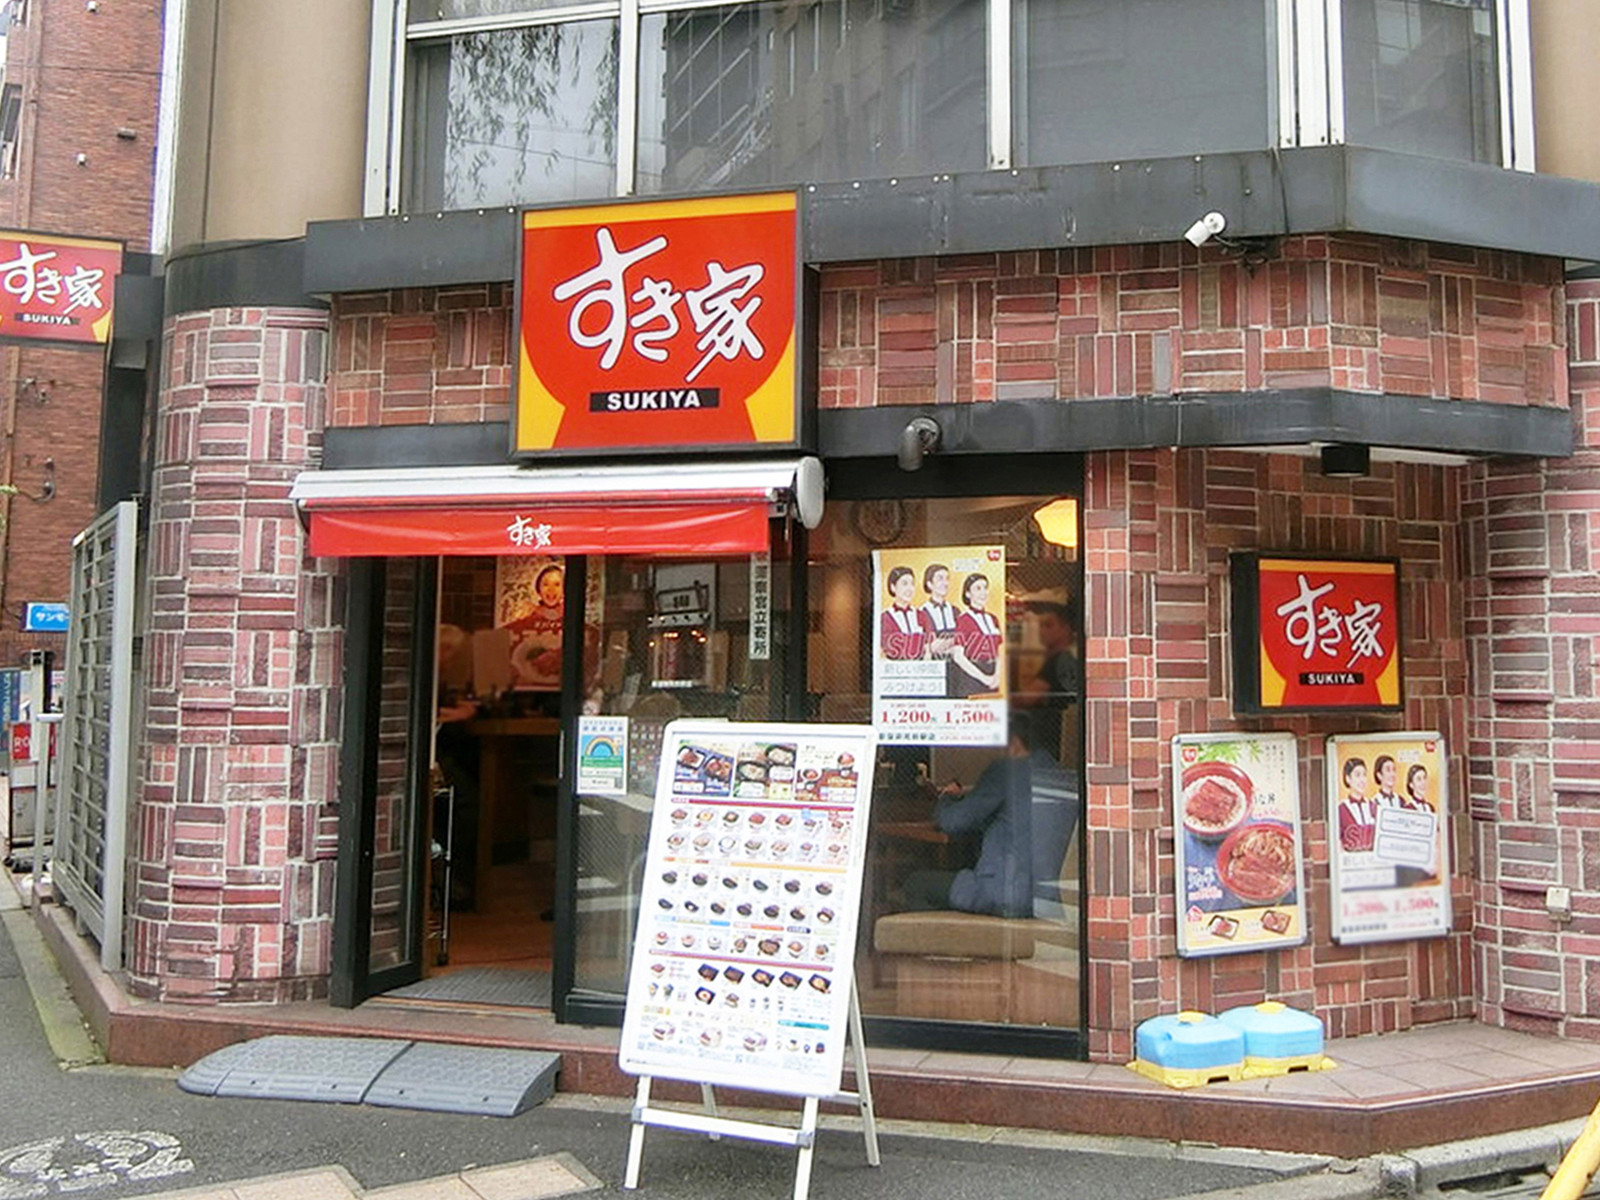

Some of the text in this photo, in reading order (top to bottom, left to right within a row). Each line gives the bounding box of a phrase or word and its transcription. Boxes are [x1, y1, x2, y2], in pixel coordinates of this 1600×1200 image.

[0, 243, 104, 315] すき家
[22, 313, 72, 325] SUKIYA
[553, 226, 767, 383] すき家
[607, 389, 702, 411] SUKIYA
[506, 514, 552, 550] すき家
[1276, 574, 1384, 669] すき家
[1307, 673, 1356, 684] SUKIYA
